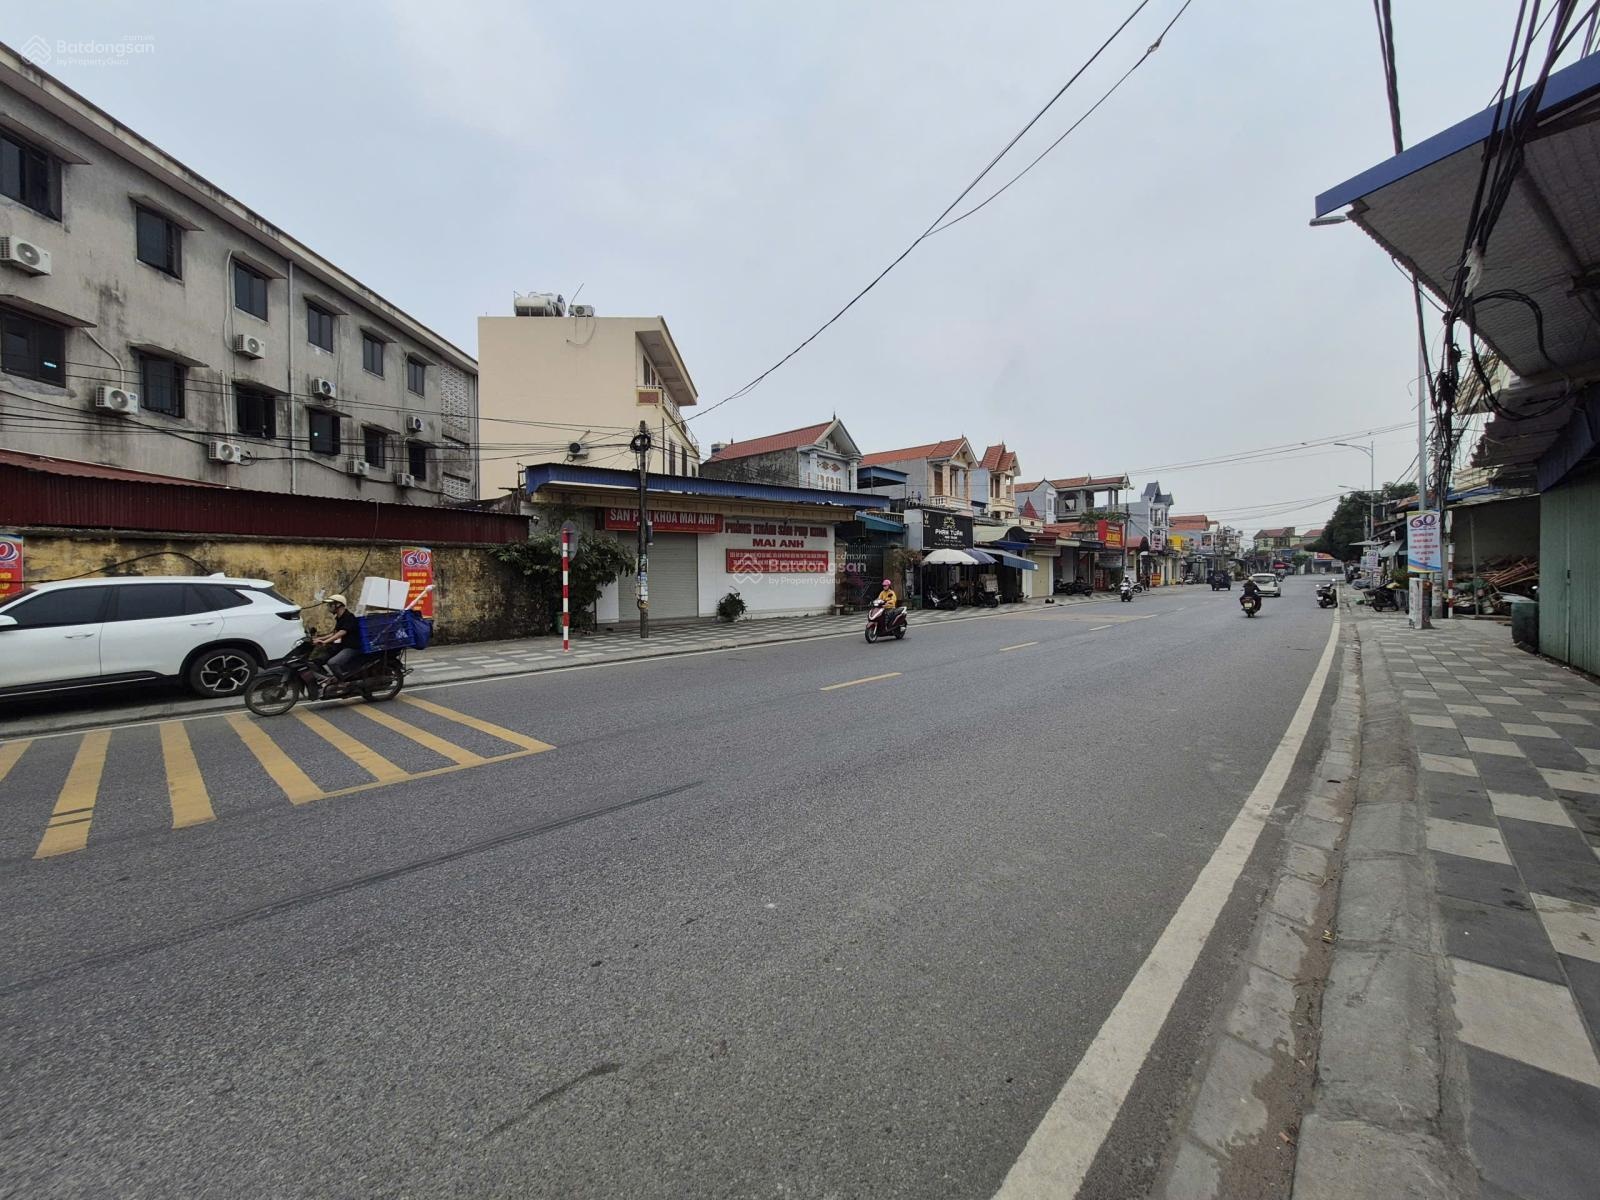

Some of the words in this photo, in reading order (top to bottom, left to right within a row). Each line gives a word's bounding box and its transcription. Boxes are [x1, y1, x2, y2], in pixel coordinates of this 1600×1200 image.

[654, 511, 677, 523] KHOA
[679, 513, 696, 524] MAI
[698, 514, 715, 525] ANH
[1409, 514, 1435, 528] 60
[752, 538, 775, 547] MAI
[780, 539, 804, 548] ANH
[404, 551, 429, 566] 60
